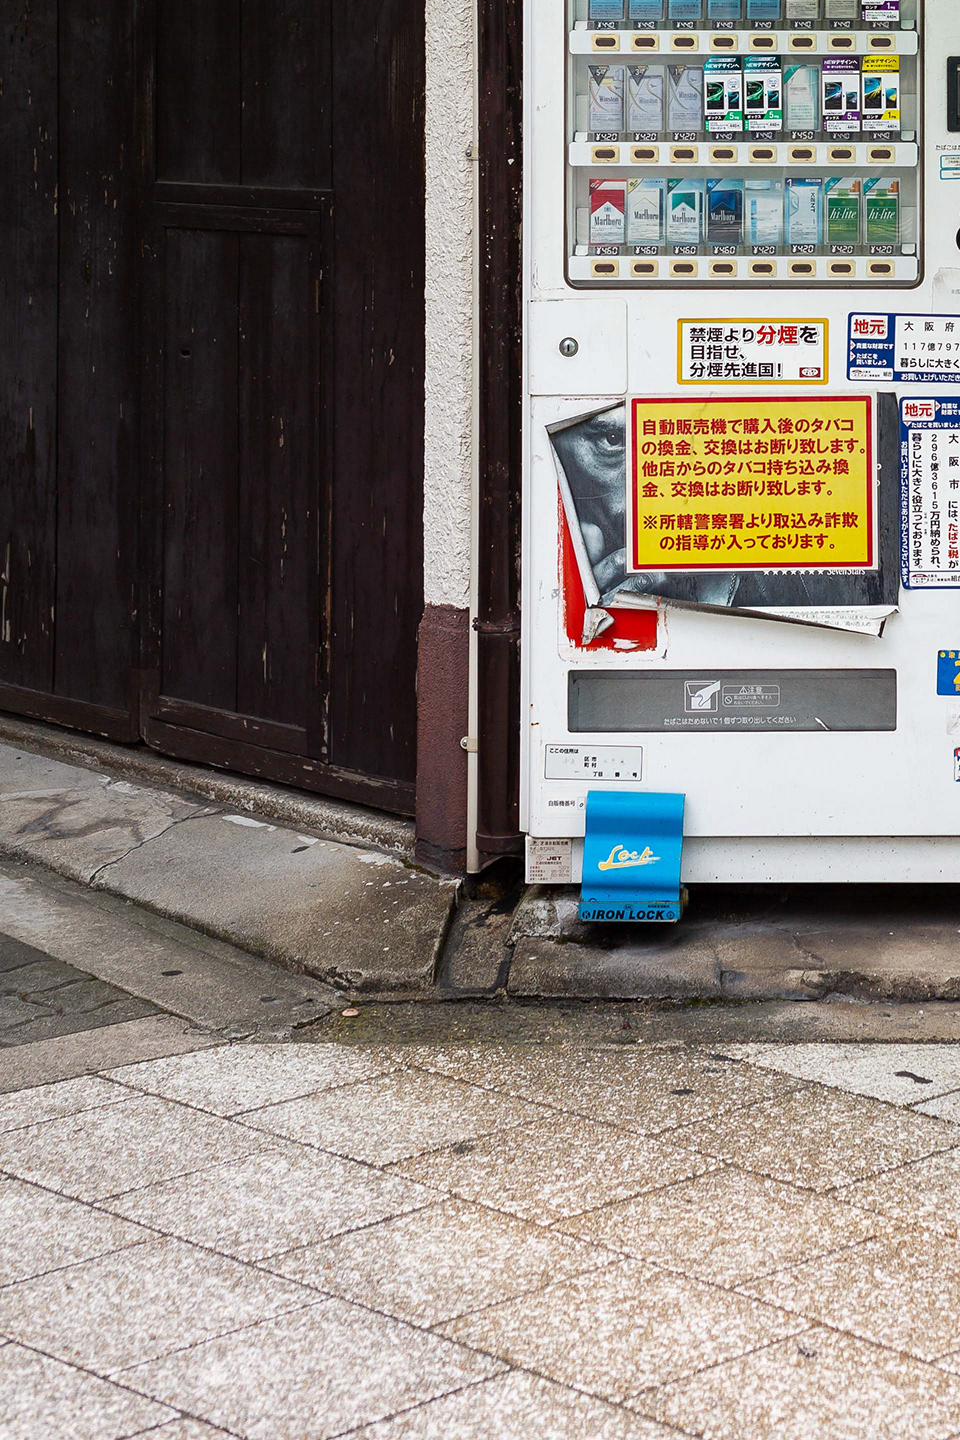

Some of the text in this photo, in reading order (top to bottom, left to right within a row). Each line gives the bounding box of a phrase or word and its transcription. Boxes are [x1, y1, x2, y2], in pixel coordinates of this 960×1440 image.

[595, 132, 618, 141] ¥420
[634, 132, 657, 141] ¥420
[674, 132, 696, 141] ¥420
[791, 132, 814, 140] ¥450
[594, 214, 622, 226] Marlboro
[634, 209, 659, 220] Marlboro
[671, 212, 696, 223] Marlboro
[710, 210, 736, 221] Marlboro
[596, 246, 618, 255] ¥460
[635, 246, 657, 255] ¥460
[675, 246, 696, 254] ¥460
[714, 246, 736, 254] ¥460
[754, 246, 775, 254] ¥420
[792, 245, 814, 253] ¥420
[831, 245, 853, 253] ¥420
[870, 246, 892, 254] ¥420
[853, 319, 885, 335] 地元
[904, 322, 955, 333] 大阪府
[690, 325, 818, 344] 禁煙より分煙を
[690, 345, 746, 360] 目指せ、
[904, 403, 932, 417] 地元
[642, 418, 854, 436] 自動販売機で購入後のタバコ
[641, 438, 866, 457] の換金、交換はお断り致します。
[641, 459, 850, 477] 他店からのタバコ持ち込み換
[642, 480, 833, 499] 金、交換はお断り致します。
[911, 432, 923, 569] 暮らしに大きく役立っております。
[948, 433, 959, 569] 大阪市 には、たばこ税が
[900, 441, 909, 586] お買い上げいただきありがとうございます。
[643, 512, 859, 531] ※所轄警察署より取込み詐欺
[659, 533, 837, 552] の指導が入っております。
[930, 511, 941, 568] 万円納められ、
[747, 686, 763, 694] 注意
[663, 716, 797, 726] たばこはためないで1個ずつ取り出してください
[599, 844, 661, 871] Lock
[591, 910, 666, 920] IRON LOCK
